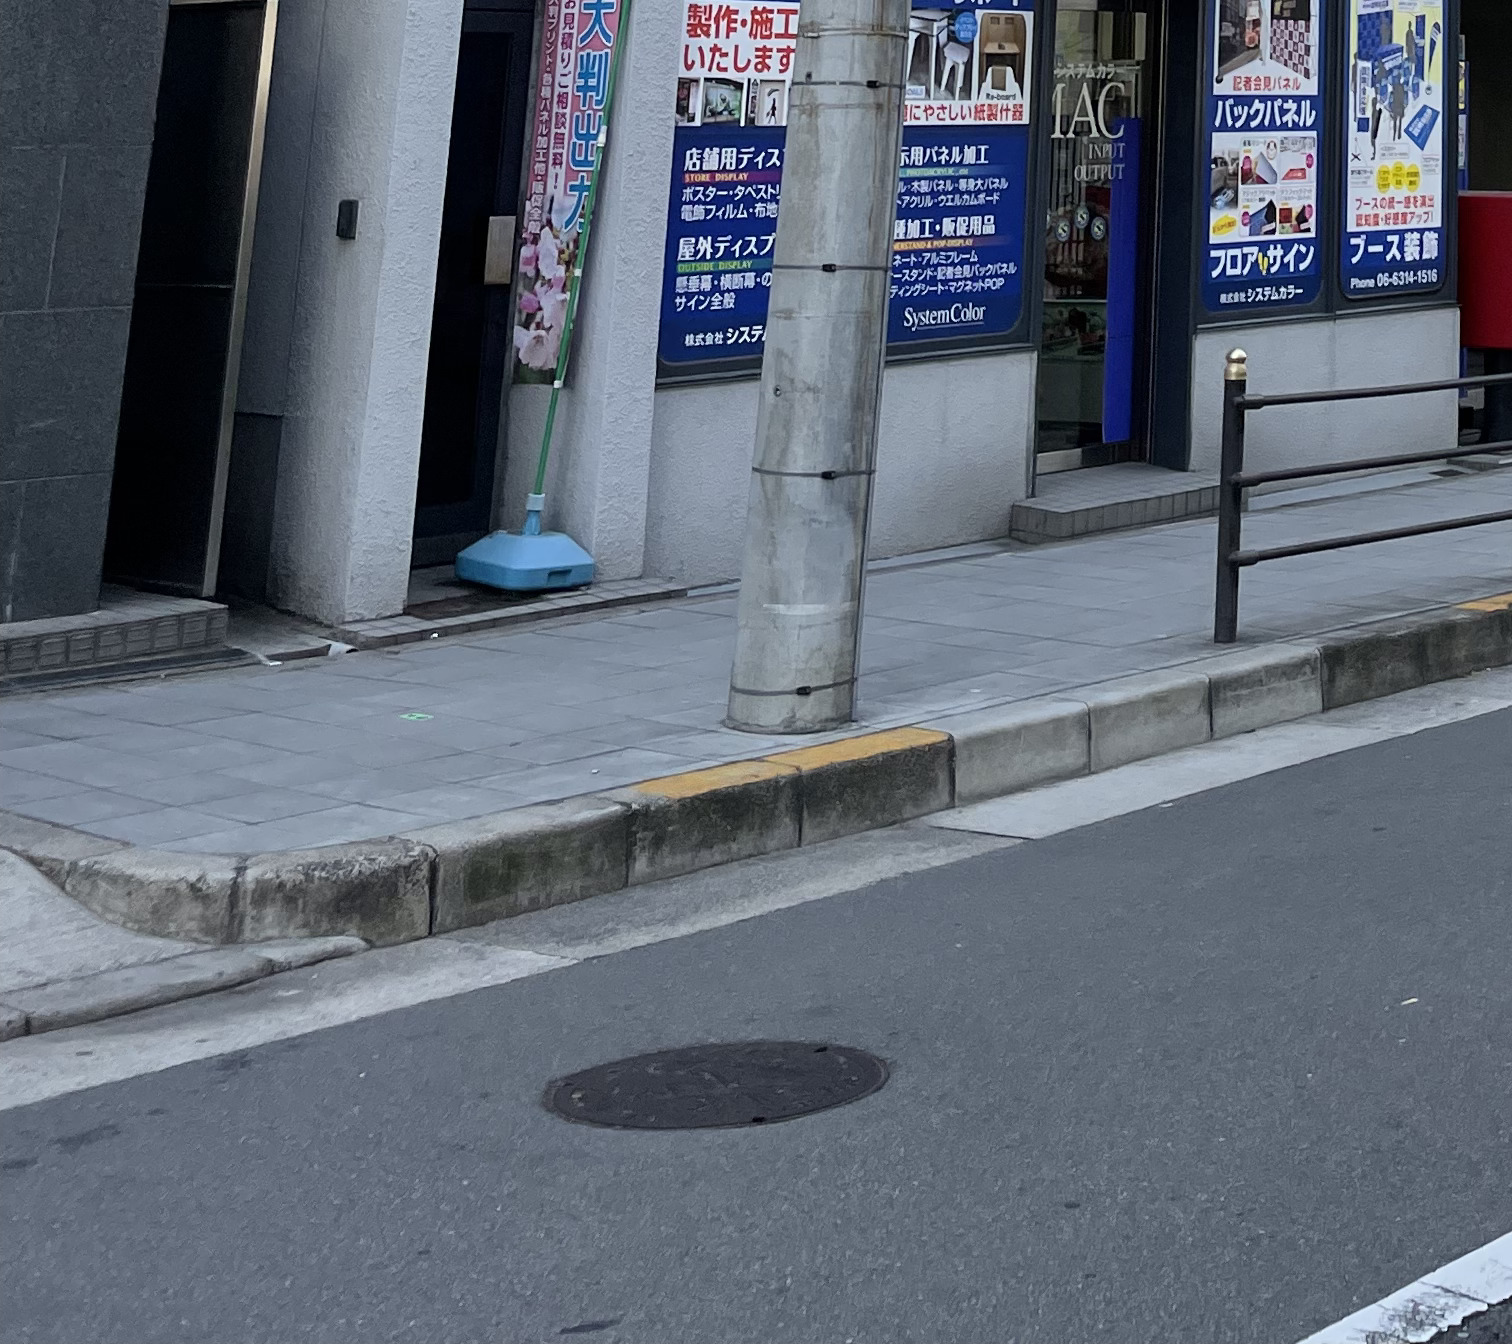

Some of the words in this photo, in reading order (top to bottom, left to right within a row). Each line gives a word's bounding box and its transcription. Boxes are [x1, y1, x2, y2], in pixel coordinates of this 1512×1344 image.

[686, 2, 799, 40] 製作・施工
[683, 43, 796, 74] いたします
[1232, 75, 1301, 92] 記者会見パネル
[1214, 98, 1316, 128] バックパネル
[683, 147, 786, 172] 店舗用ディス
[1088, 142, 1126, 160] INPUT
[714, 172, 749, 182] DISPLAY
[1074, 163, 1126, 182] OUTPUT
[1350, 231, 1440, 264] ブース装飾
[1377, 269, 1438, 288] 06-6314-1516
[684, 325, 767, 347] 株式会社システ
